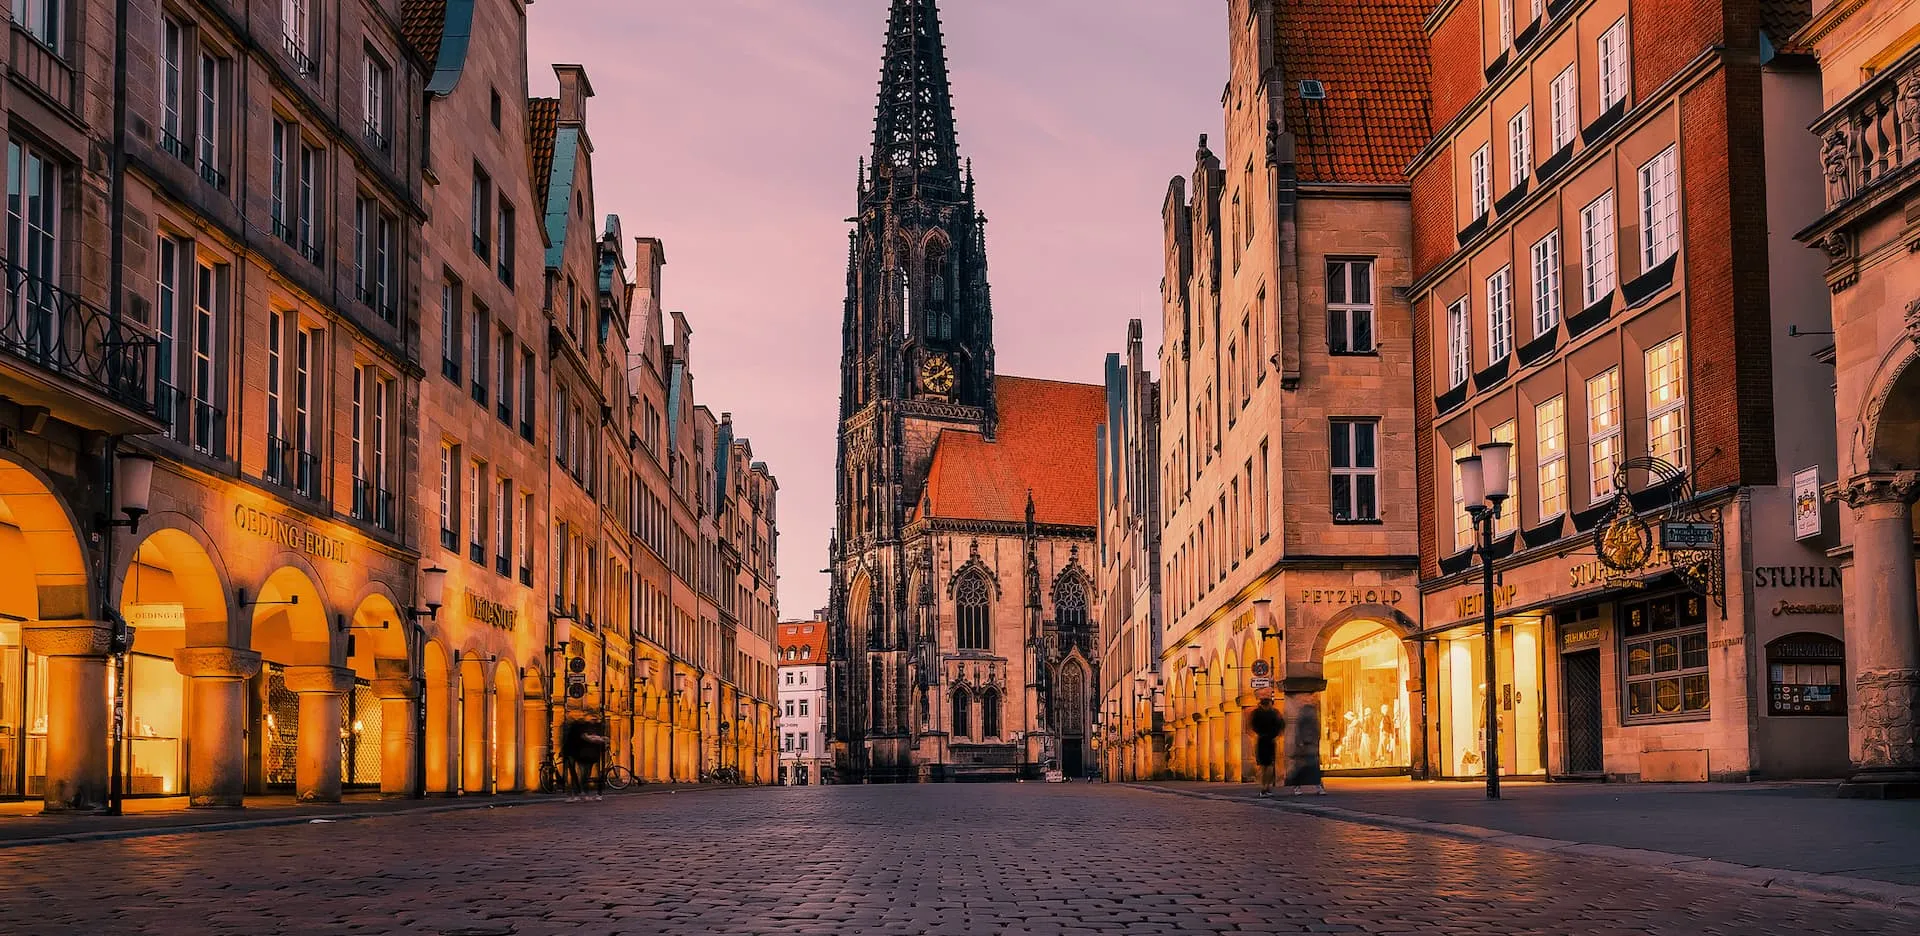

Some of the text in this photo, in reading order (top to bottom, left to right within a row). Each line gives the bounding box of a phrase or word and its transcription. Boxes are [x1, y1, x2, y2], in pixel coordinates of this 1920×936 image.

[235, 504, 348, 564] OEDING-ERDEL
[1301, 590, 1402, 605] PETZHOLD
[1456, 584, 1517, 618] WEITAMP
